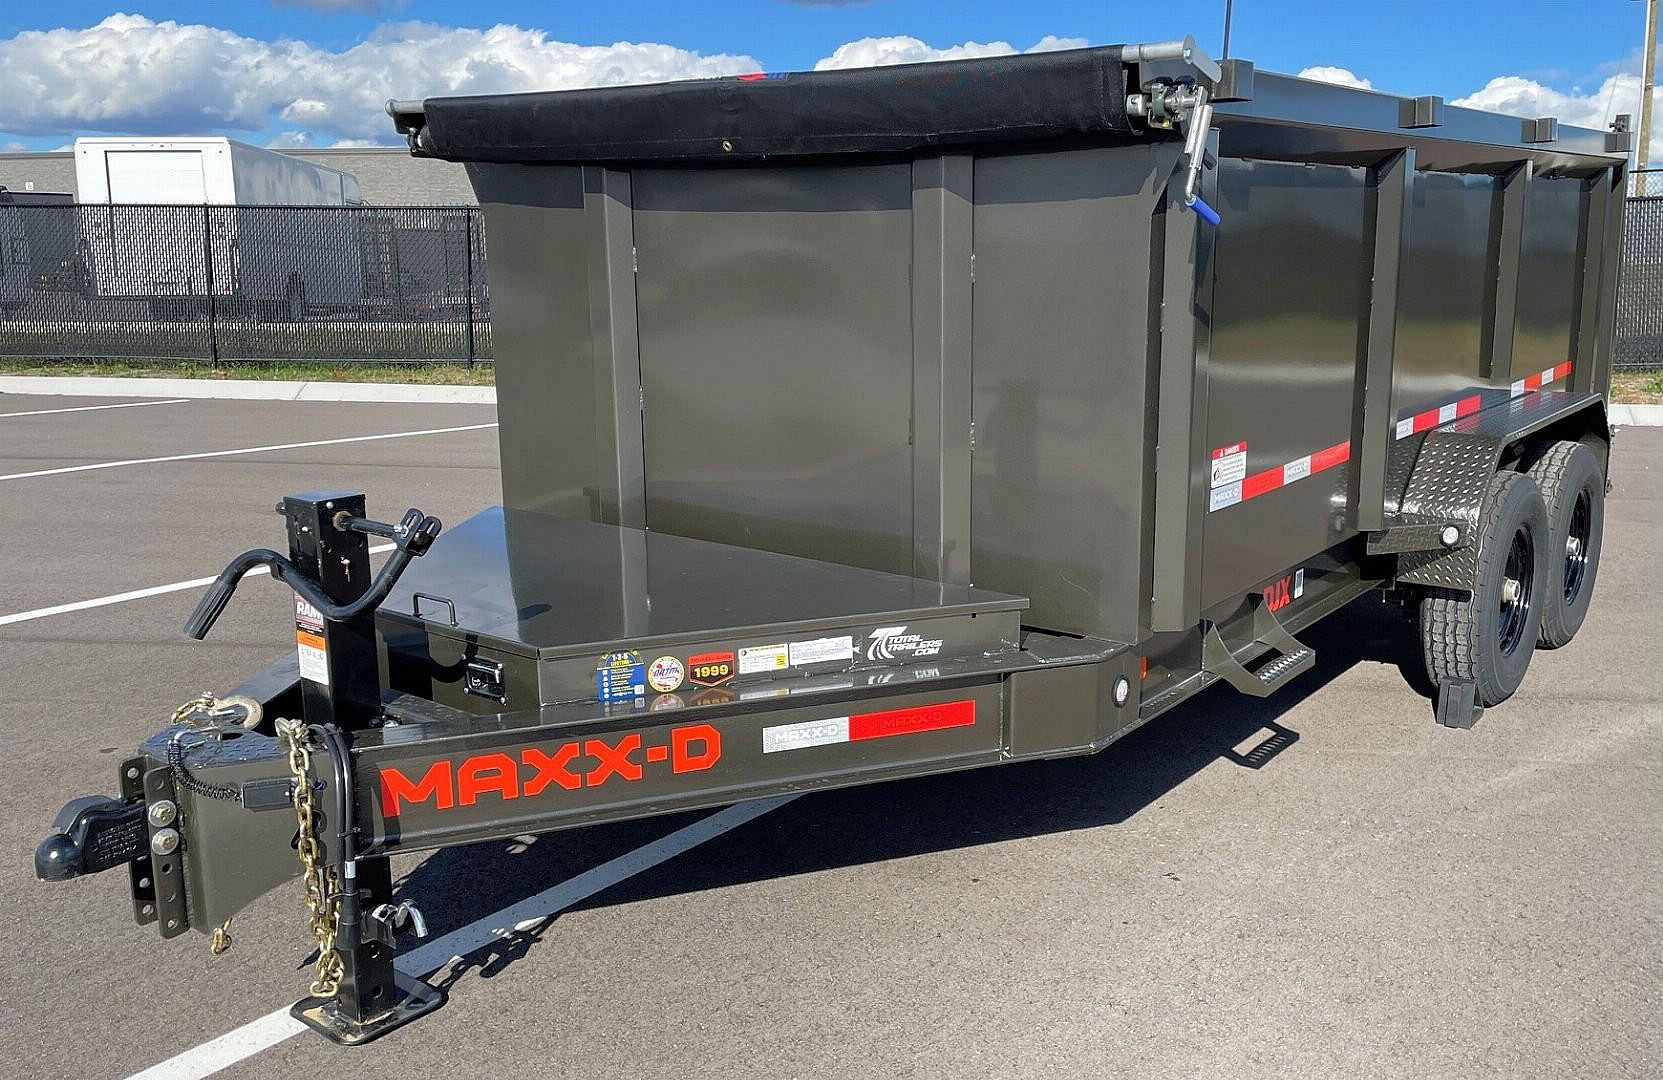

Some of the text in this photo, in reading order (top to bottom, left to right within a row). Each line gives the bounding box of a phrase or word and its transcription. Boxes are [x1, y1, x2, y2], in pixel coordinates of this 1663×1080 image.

[888, 640, 943, 651] TRAILERS
[889, 635, 923, 644] TOTAL
[912, 647, 940, 656] .COM
[694, 664, 729, 678] 1999
[881, 711, 943, 729] MAXX-D
[774, 724, 838, 744] MAXX-D
[379, 724, 722, 817] MAXX-D
